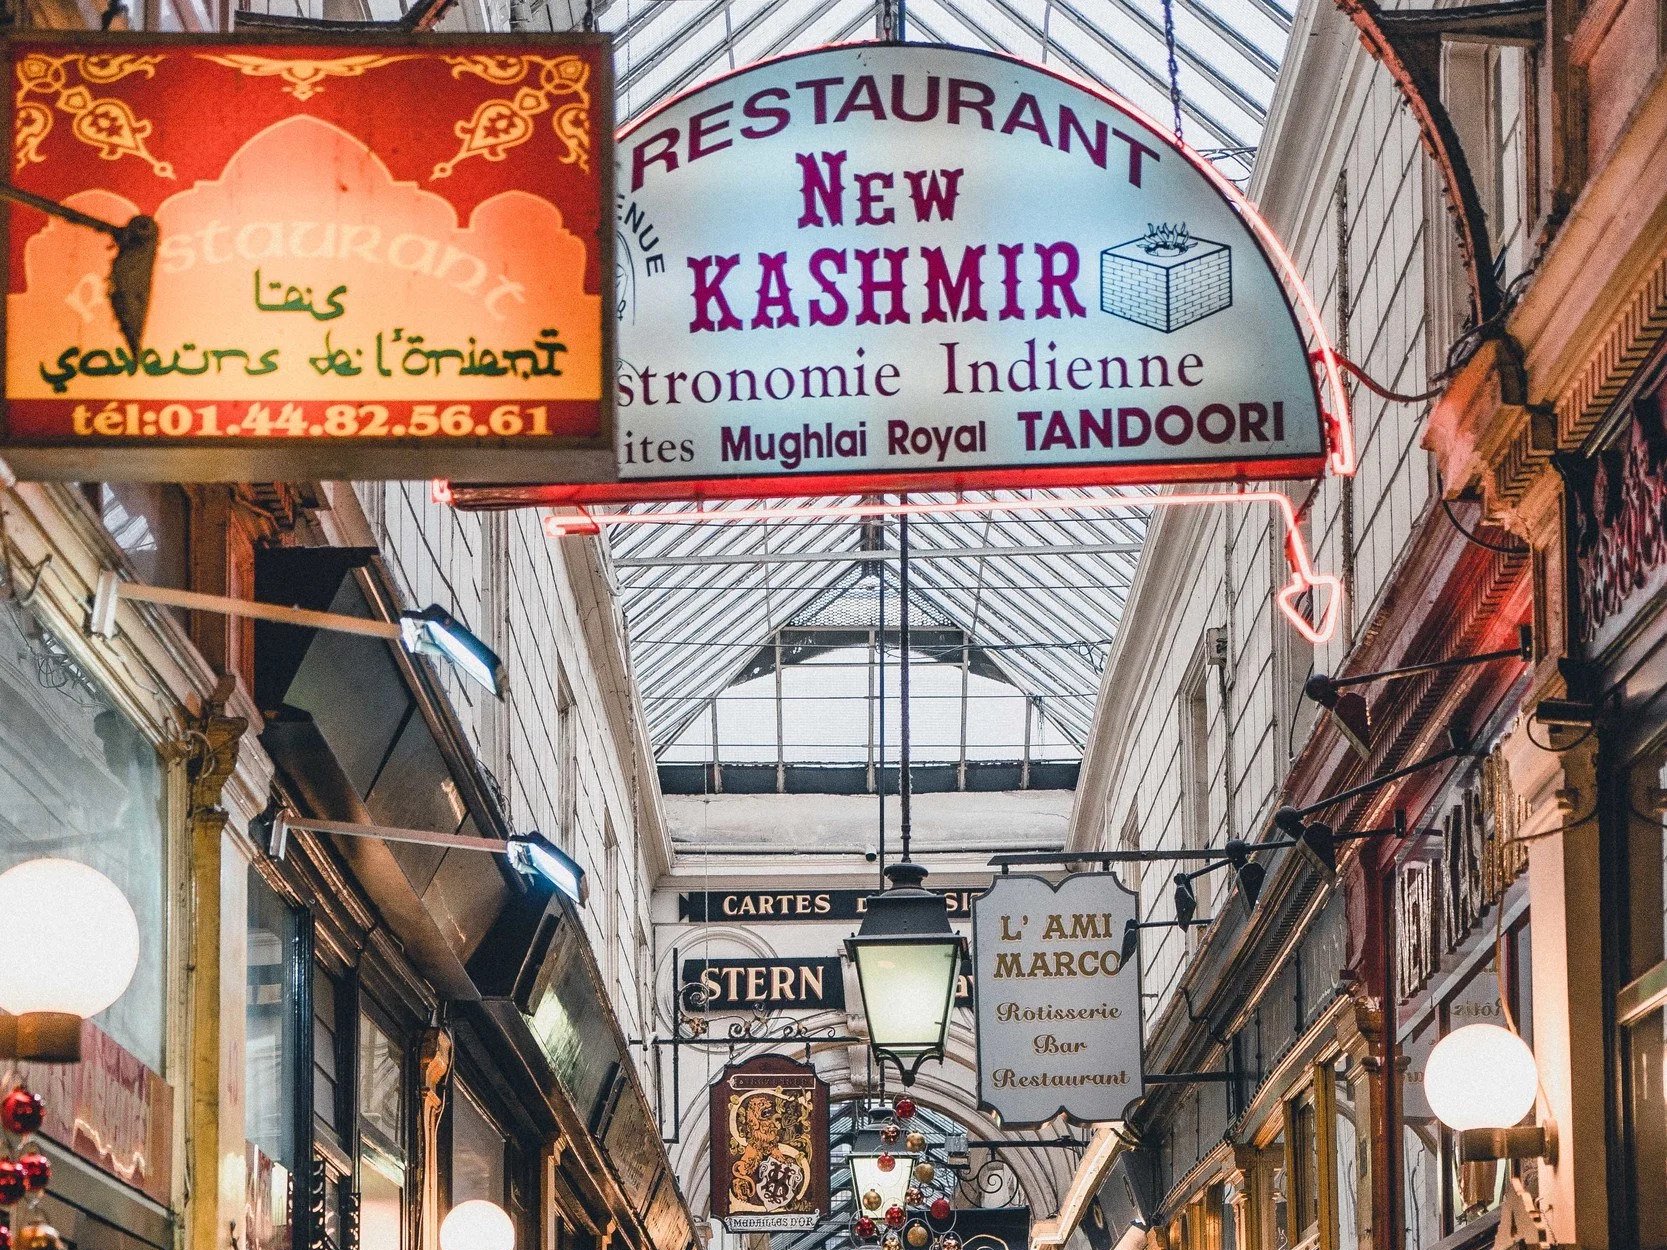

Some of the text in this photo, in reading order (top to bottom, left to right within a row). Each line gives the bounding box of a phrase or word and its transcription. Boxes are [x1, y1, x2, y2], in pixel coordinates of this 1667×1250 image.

[630, 74, 1162, 192] RESTAURANT
[686, 241, 1087, 333] KASHMIR
[940, 338, 1205, 396] Indienne
[618, 401, 1285, 469] ites Mughlai Royal TANDOORI
[722, 894, 831, 916] CARTES
[1042, 912, 1114, 940] AMI
[1395, 858, 1433, 1005] NEW
[993, 950, 1122, 979] MARCO
[702, 965, 825, 1001] STERN
[996, 1002, 1122, 1022] Rôtisserie
[1033, 1034, 1088, 1055] Bar
[992, 1068, 1131, 1089] Restaurant
